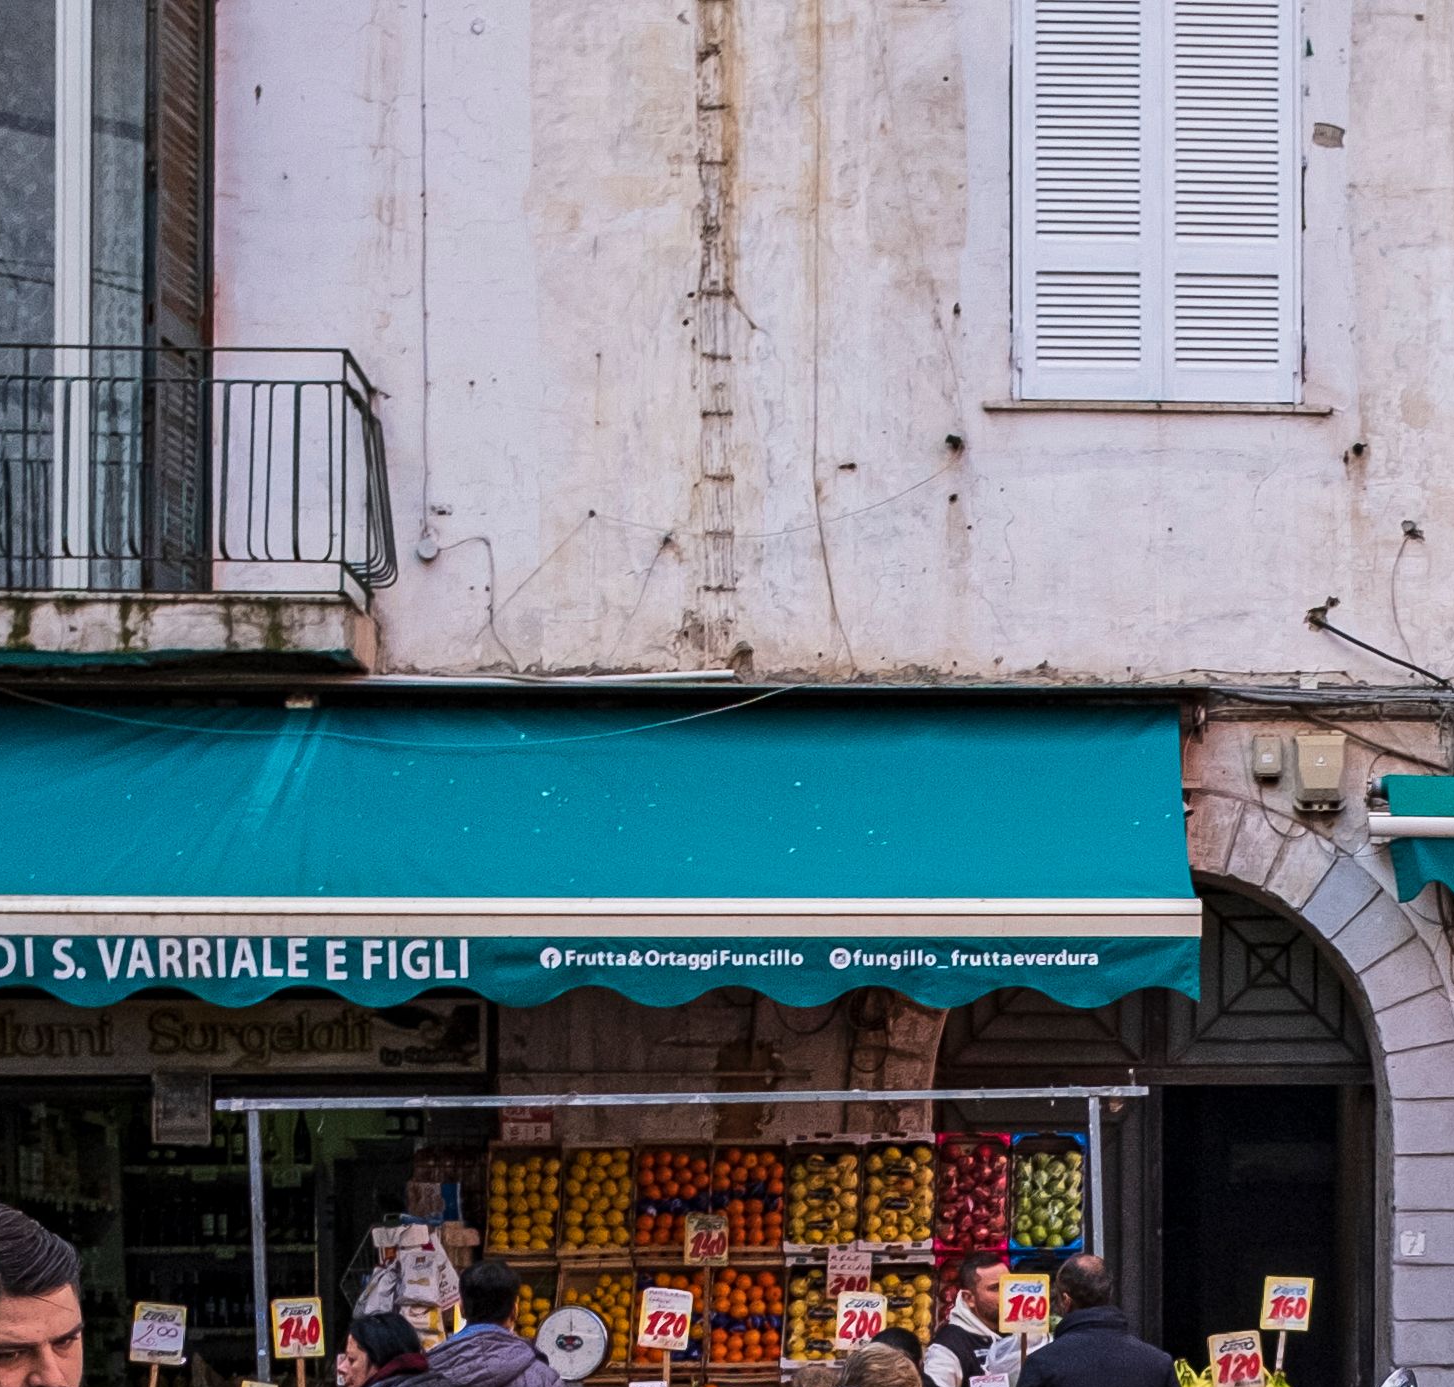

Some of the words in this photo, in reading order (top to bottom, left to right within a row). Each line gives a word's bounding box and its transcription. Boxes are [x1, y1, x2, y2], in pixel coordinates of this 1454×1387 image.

[52, 939, 87, 980] S.
[96, 938, 310, 979] VARRIALE
[325, 940, 347, 980] E
[361, 940, 469, 980] FIGLI
[565, 949, 803, 971] Frutta&OrtaggiFuncillo
